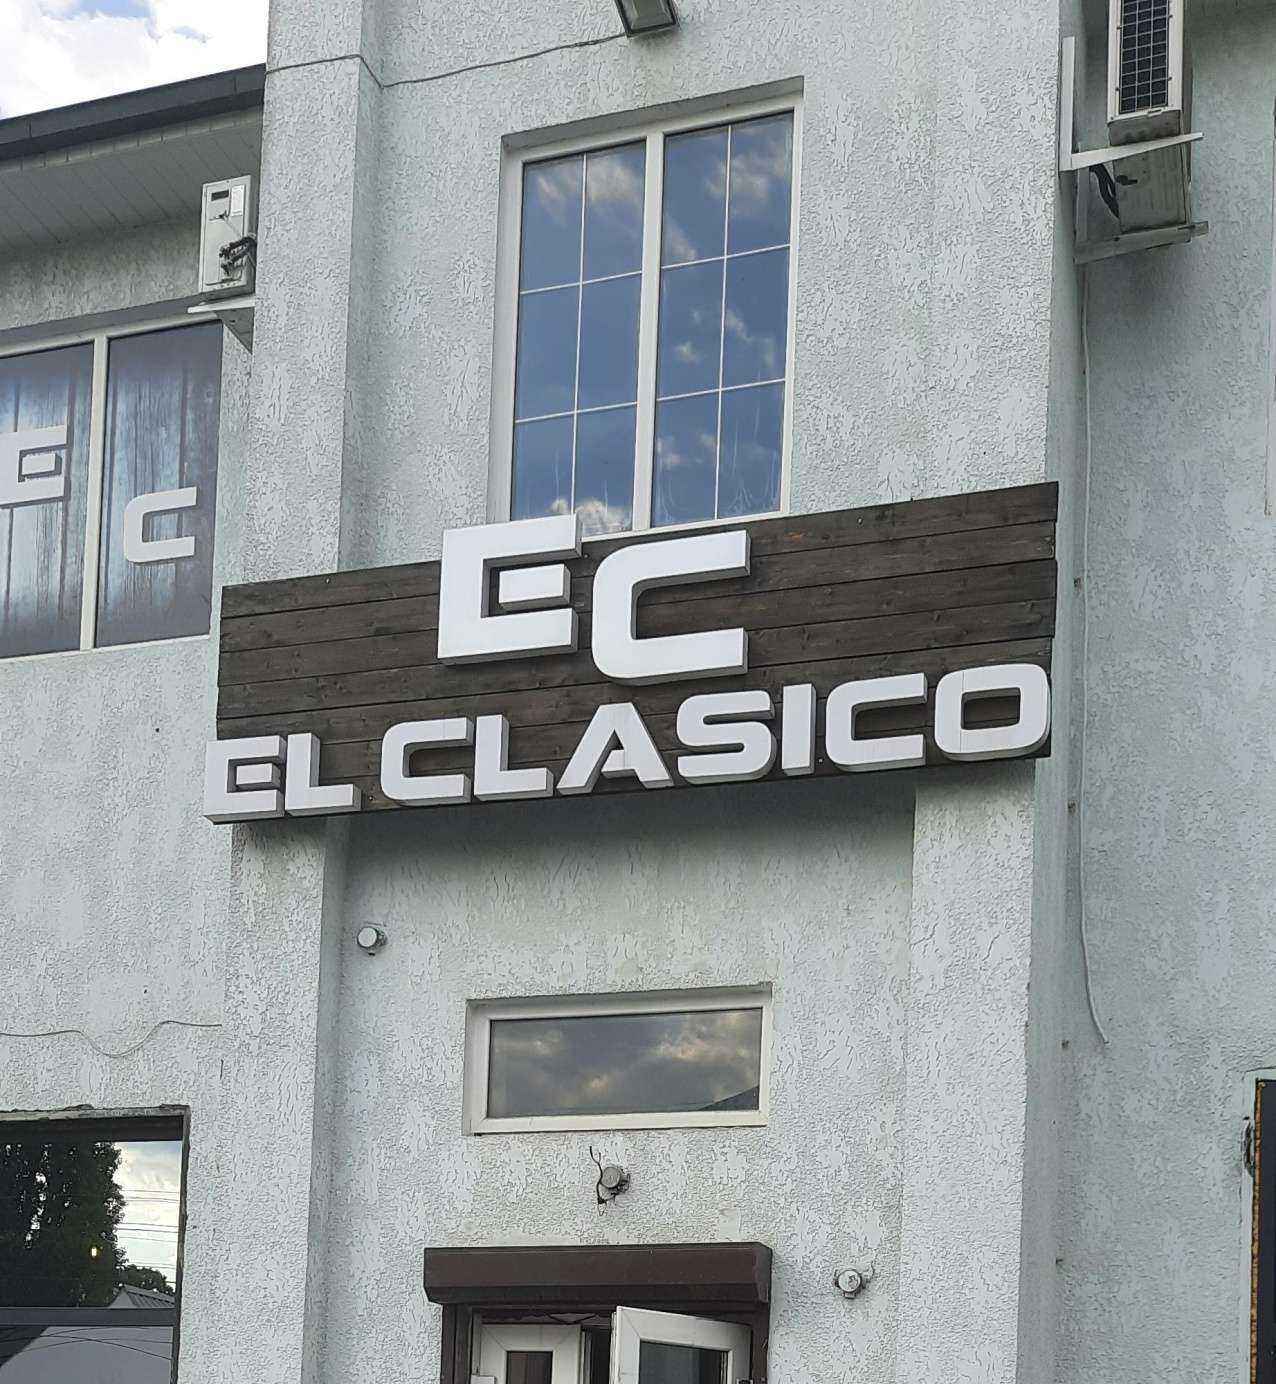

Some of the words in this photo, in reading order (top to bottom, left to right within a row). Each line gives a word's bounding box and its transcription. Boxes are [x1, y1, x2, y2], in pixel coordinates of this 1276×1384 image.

[436, 514, 752, 686] EC
[203, 732, 362, 824] EL
[380, 662, 1052, 808] CLASICO
